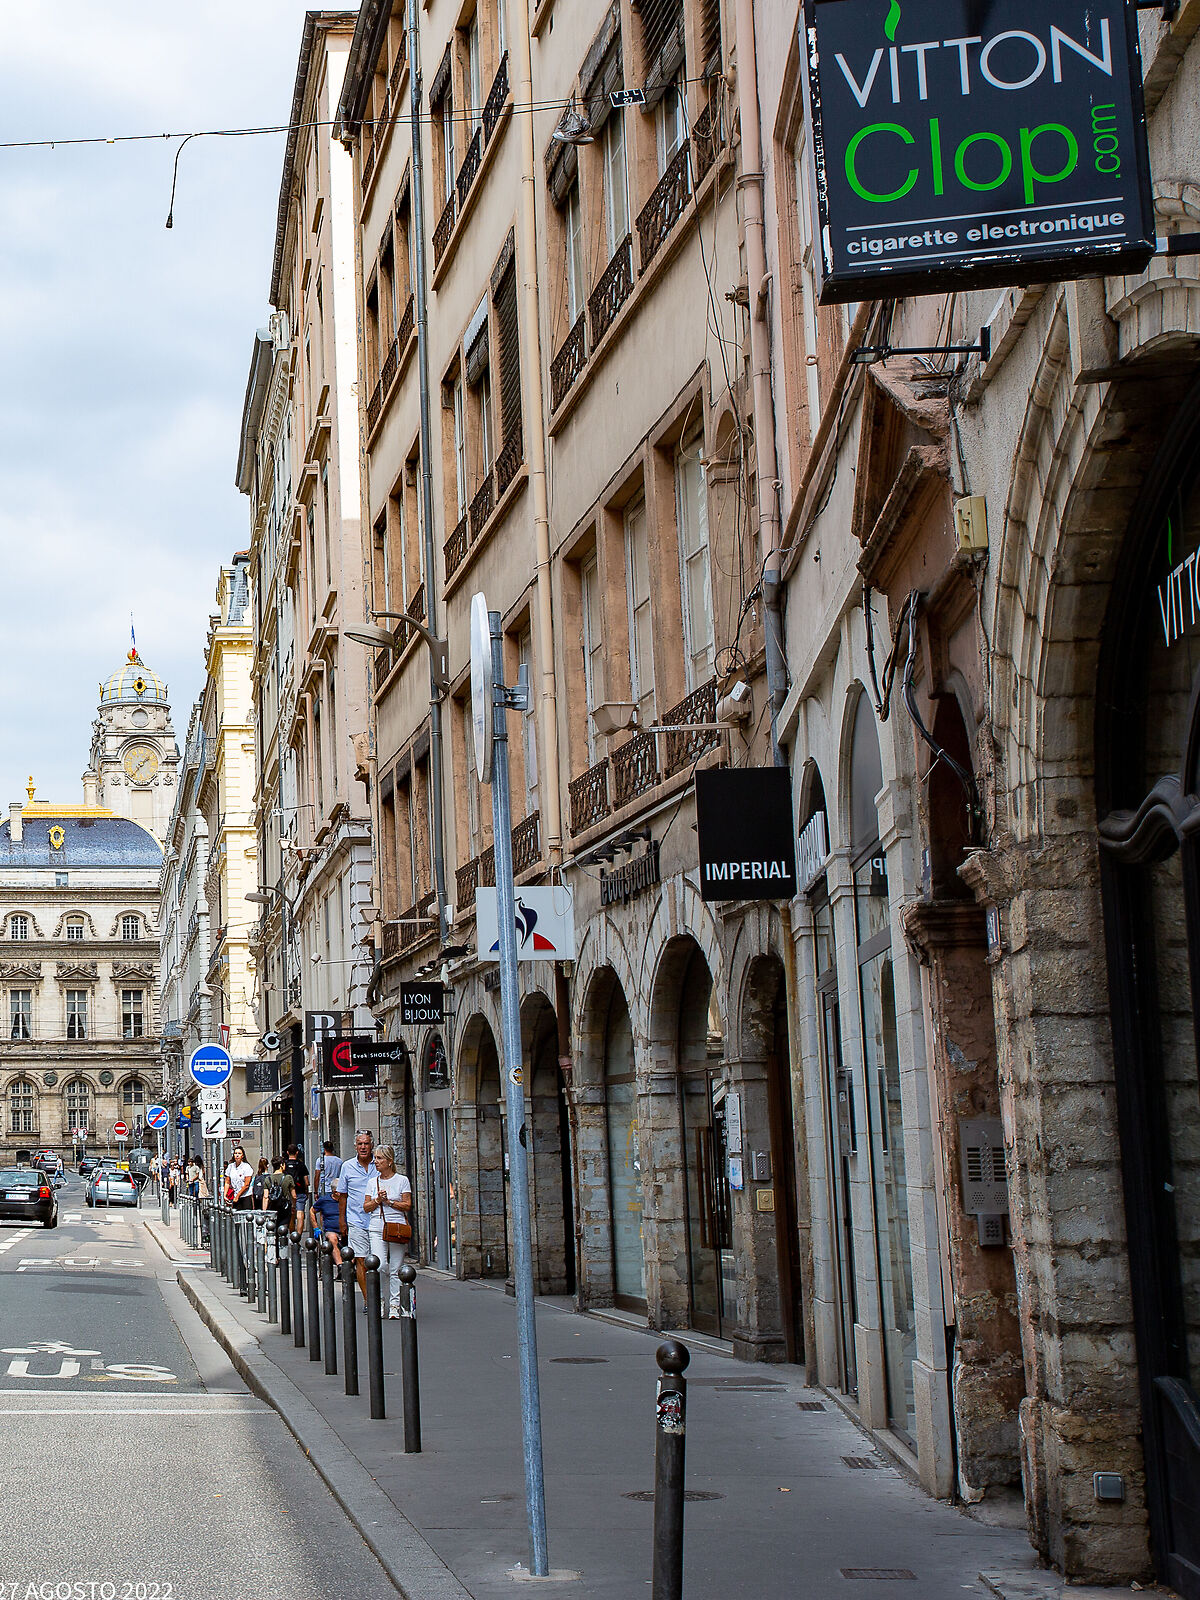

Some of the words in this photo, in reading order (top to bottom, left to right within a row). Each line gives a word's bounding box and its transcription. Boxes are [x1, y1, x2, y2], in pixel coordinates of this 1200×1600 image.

[834, 18, 1113, 108] VITTON
[844, 117, 1079, 205] Clop
[1090, 102, 1122, 179] .com
[846, 229, 959, 256] cigarette
[966, 210, 1126, 242] electronique
[705, 860, 791, 881] IMPERIAL
[404, 993, 431, 1005] LYON
[404, 1008, 441, 1023] BIJOUX
